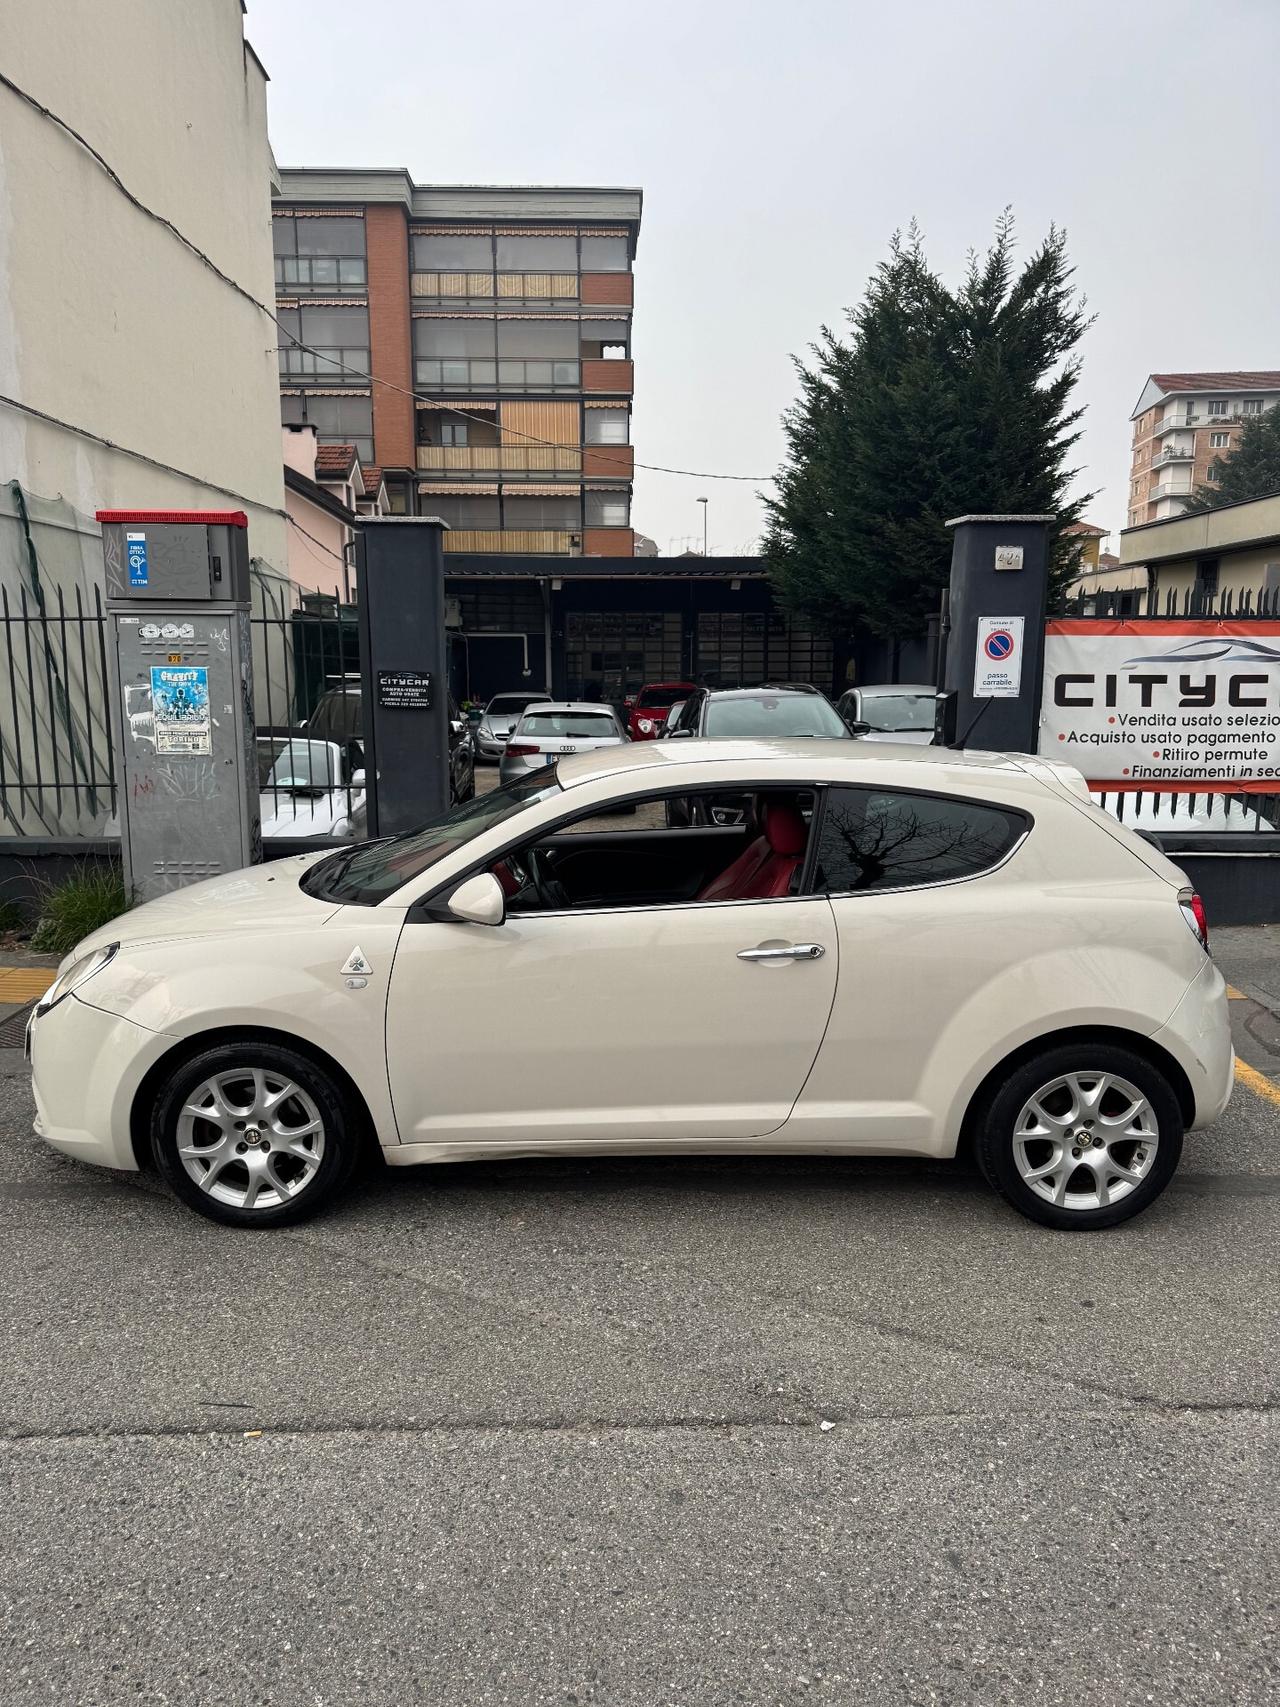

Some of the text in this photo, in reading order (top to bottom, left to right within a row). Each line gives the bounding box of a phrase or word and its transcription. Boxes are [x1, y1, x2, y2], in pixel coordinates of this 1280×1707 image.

[380, 678, 429, 686] CITYCAR
[1054, 674, 1280, 707] CITYC
[1118, 713, 1280, 727] Vendita usato selezio
[1067, 730, 1276, 747] Acquisto usato pagamento
[1162, 748, 1268, 763] Ritiro permute
[1132, 765, 1235, 778] Finanziamenti
[1240, 765, 1253, 777] in
